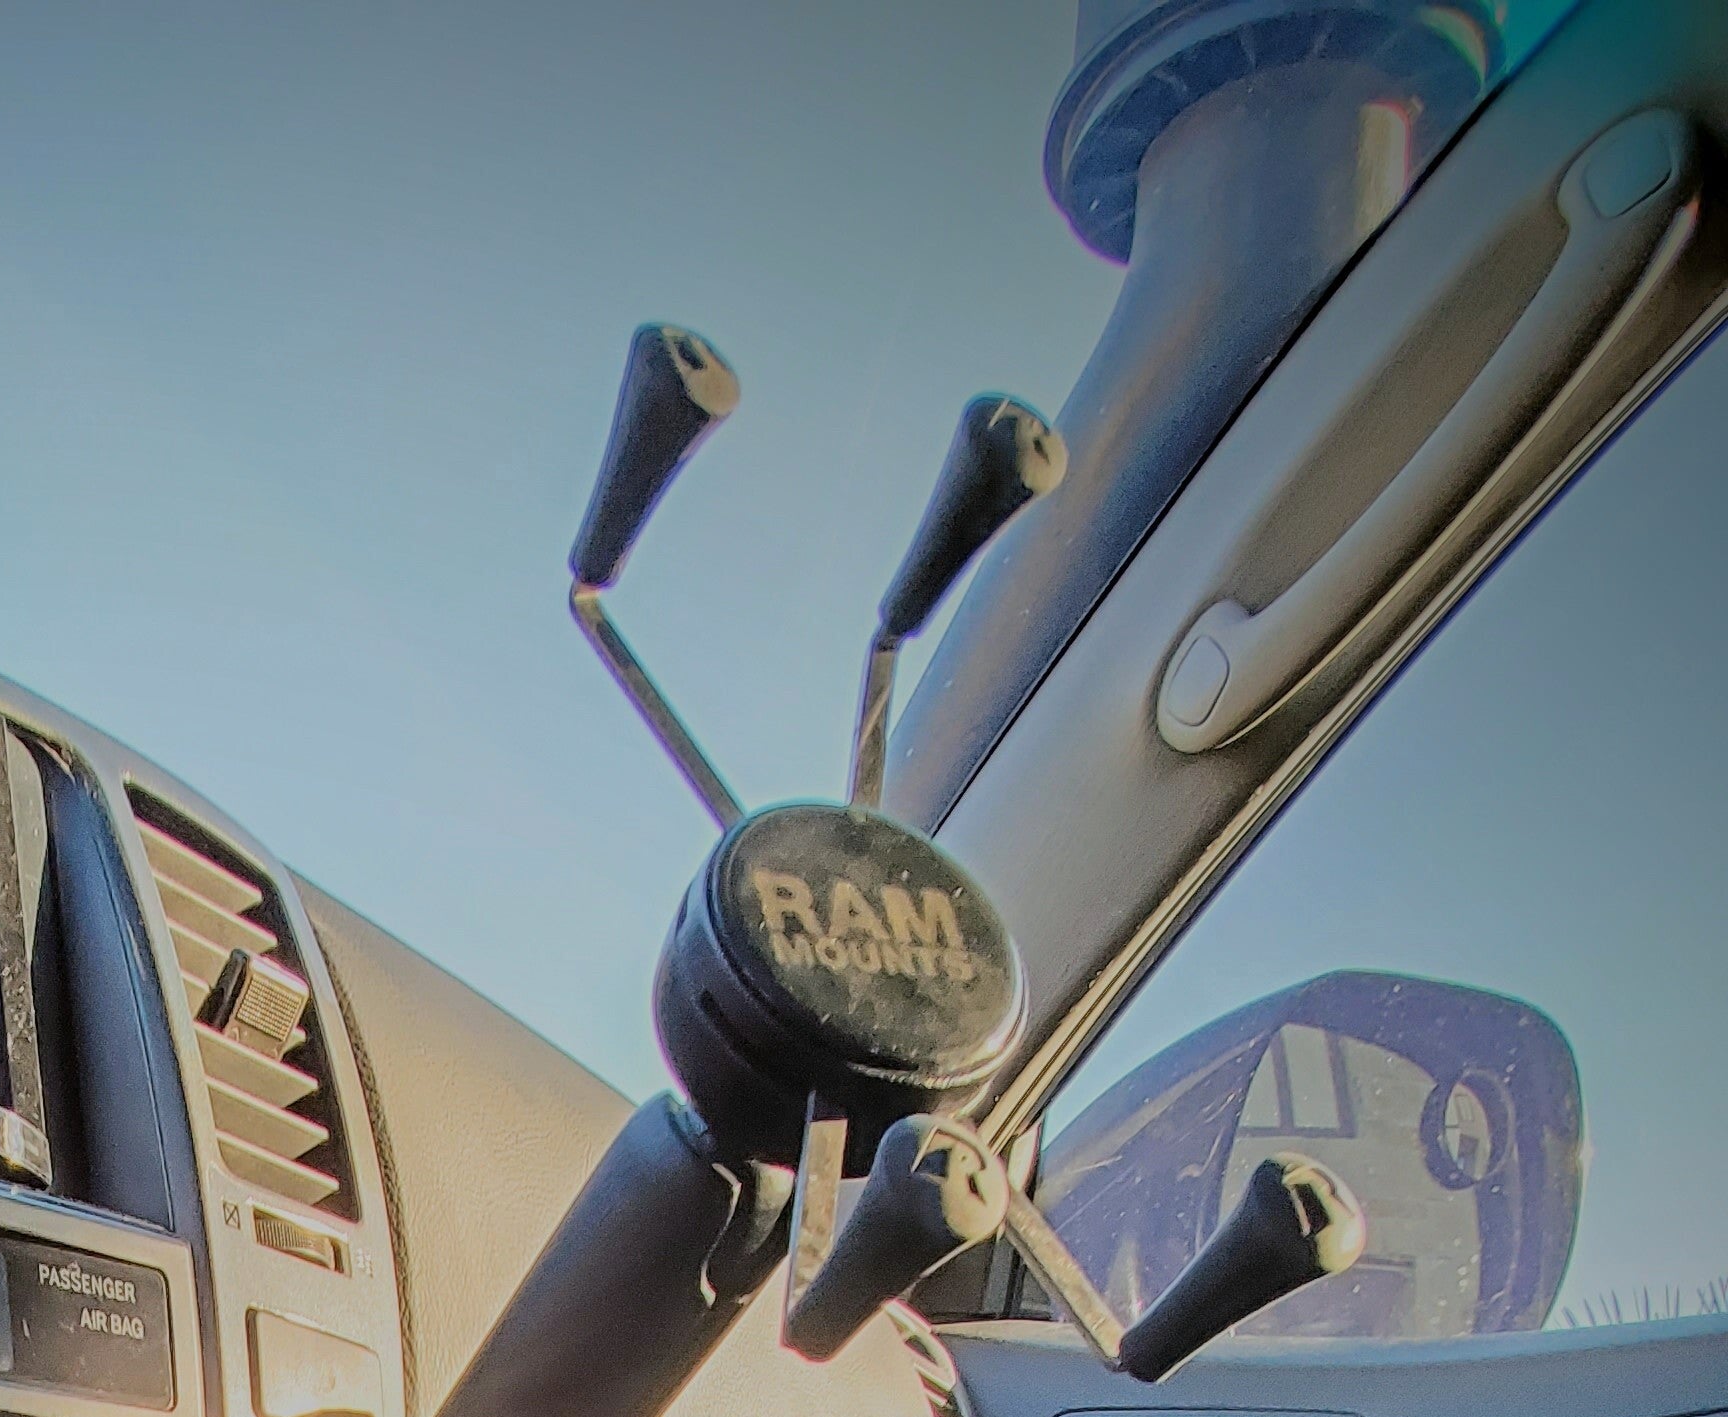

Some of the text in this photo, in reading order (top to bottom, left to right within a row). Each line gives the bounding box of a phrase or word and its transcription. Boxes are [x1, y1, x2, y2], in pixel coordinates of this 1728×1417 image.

[753, 868, 964, 950] RAM
[772, 931, 974, 981] MOUNTS
[38, 1263, 137, 1303] PASSENGER
[80, 1307, 145, 1340] AIR BAG
